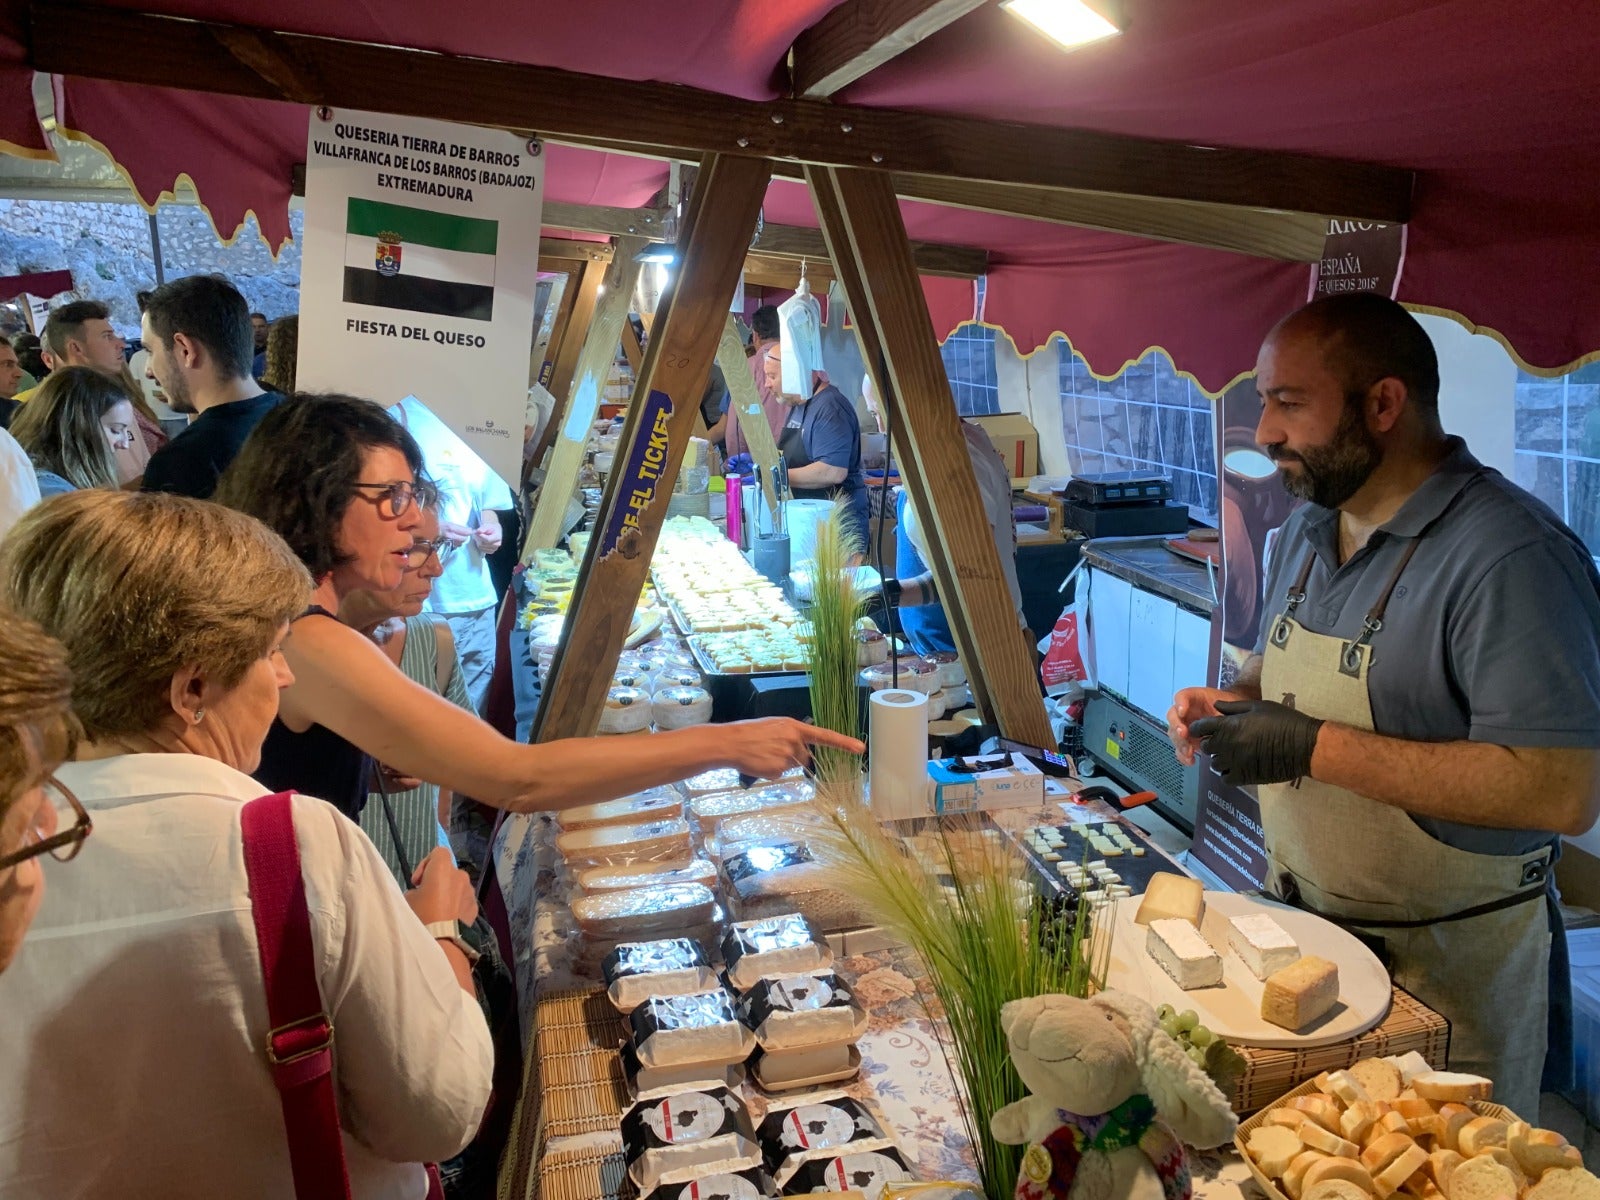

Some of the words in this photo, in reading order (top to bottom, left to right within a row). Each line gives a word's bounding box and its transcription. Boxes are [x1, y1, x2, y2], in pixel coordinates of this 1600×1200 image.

[334, 123, 400, 148] QUESERIA
[402, 135, 447, 156] TIERRA
[449, 144, 467, 159] DE
[468, 147, 520, 168] BARROS
[314, 139, 392, 168] VILLAFRANCA
[394, 154, 408, 170] DE
[410, 158, 431, 175] LOS
[432, 161, 477, 183] BARROS
[478, 169, 536, 192] (BADAJOZ)
[377, 172, 474, 203] EXTREMADURA
[1319, 252, 1362, 276] ESPAÑA
[1325, 278, 1356, 294] QUESOS
[346, 318, 398, 337] FIESTA
[401, 325, 430, 342] DEL
[433, 330, 486, 348] QUESO
[638, 407, 669, 481] TICKET
[629, 487, 654, 510] EL
[1235, 810, 1256, 832] TIERRA
